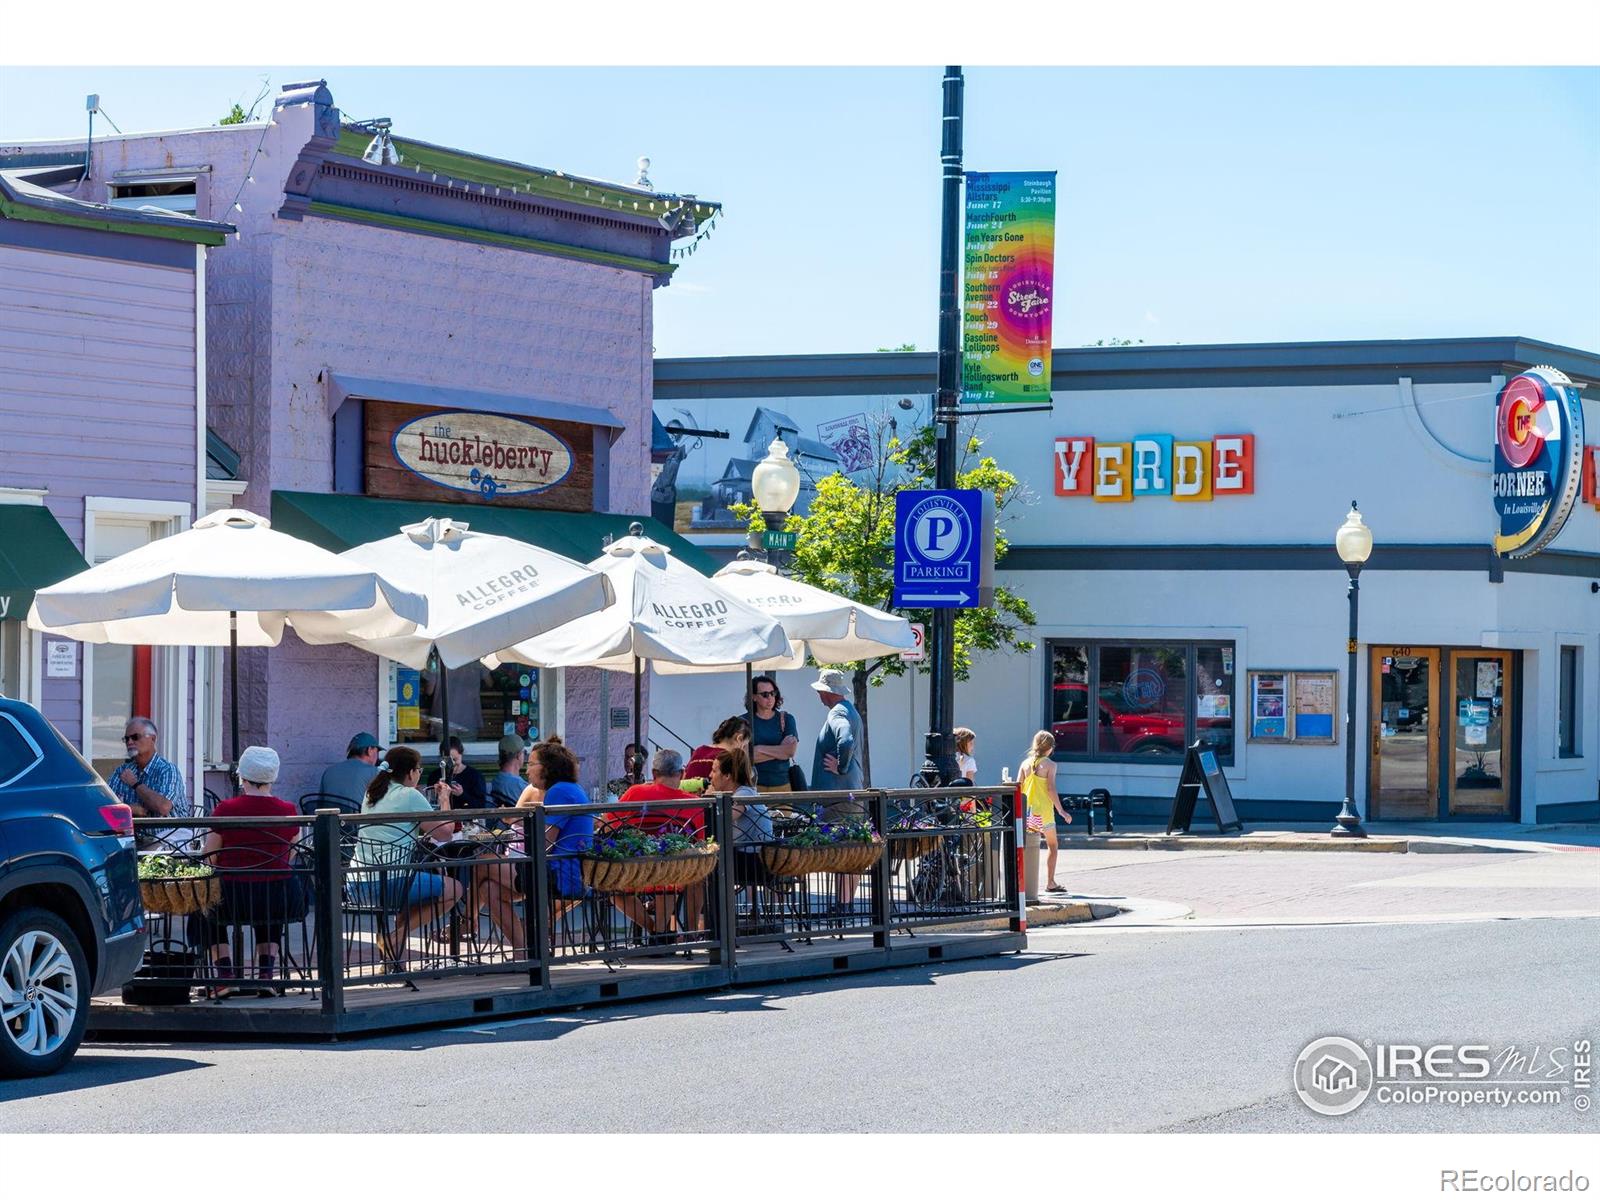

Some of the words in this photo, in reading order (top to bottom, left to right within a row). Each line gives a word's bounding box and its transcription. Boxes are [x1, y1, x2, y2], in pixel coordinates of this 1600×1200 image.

[967, 182, 1011, 193] Mississippi
[967, 192, 998, 201] Allstars
[966, 201, 989, 209] June
[967, 212, 1017, 221] MarchFourth
[966, 222, 989, 230] June
[991, 221, 1003, 229] 24
[966, 233, 979, 242] Ten
[980, 233, 1003, 242] Years
[1004, 232, 1024, 242] Gone
[966, 242, 986, 250] July
[966, 254, 982, 264] Spin
[984, 253, 1015, 263] Doctors
[966, 272, 985, 280] July
[989, 271, 998, 279] 15
[965, 282, 1001, 291] Southern
[1008, 290, 1038, 304] Street
[965, 301, 985, 310] July
[987, 301, 998, 309] 22
[1021, 297, 1049, 312] Faire
[965, 313, 989, 322] Couch
[965, 322, 985, 330] July
[986, 321, 998, 329] 29
[965, 333, 998, 342] Gasoline
[965, 343, 1000, 353] Lollipops
[965, 352, 982, 361] Aug
[965, 363, 981, 372] Kyle
[965, 372, 1018, 384] Hollingsworth
[965, 382, 983, 391] Band
[965, 391, 982, 400] Aug
[984, 390, 995, 398] 12
[434, 421, 451, 439] the
[418, 432, 553, 477] huckleberry
[1055, 438, 1243, 496] VERDE
[1492, 470, 1546, 498] CORNER
[912, 499, 964, 521] LOUISVILLE
[1504, 503, 1511, 514] In
[1512, 502, 1540, 515] Louisville
[924, 517, 953, 551] P
[769, 533, 787, 547] MAIN
[911, 566, 963, 577] PARKING
[455, 564, 539, 607] ALLEGRO
[473, 580, 540, 611] COFFEE
[652, 599, 728, 619] ALLEGRO
[665, 617, 727, 628] COFFEE
[1392, 646, 1411, 657] 640
